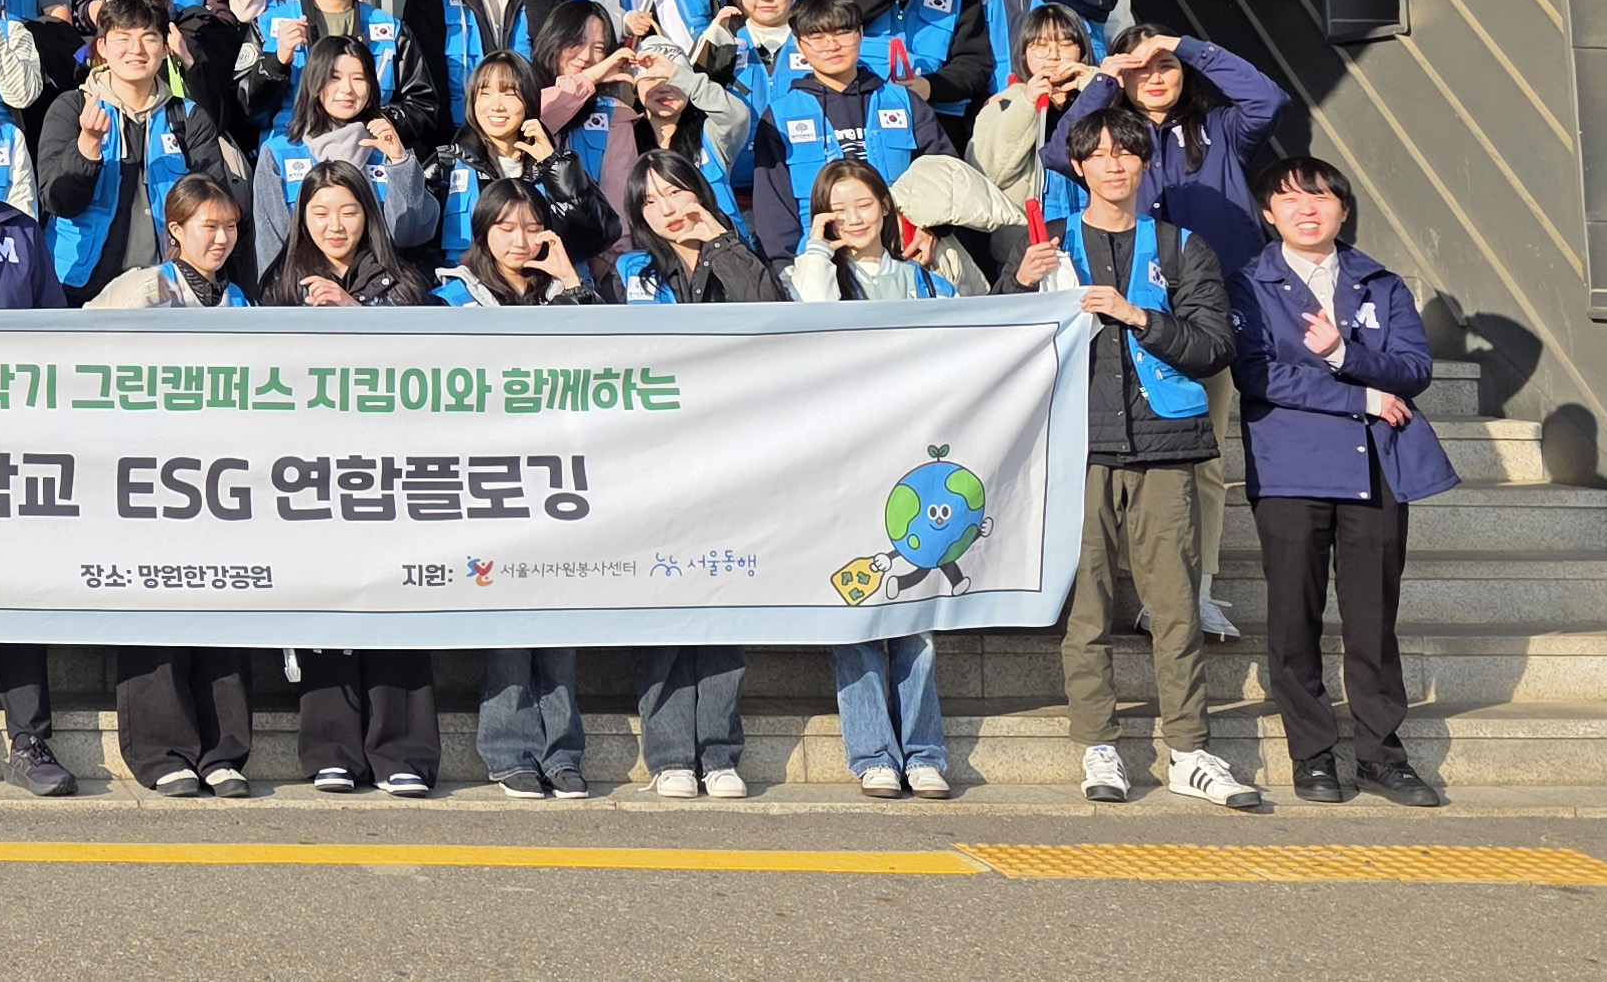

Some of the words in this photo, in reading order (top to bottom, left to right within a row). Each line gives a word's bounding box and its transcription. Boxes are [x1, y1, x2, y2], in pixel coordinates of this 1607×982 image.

[71, 364, 296, 411] 그린캠퍼스
[306, 367, 493, 413] 지킴이와
[501, 367, 682, 412] 함께하는
[116, 456, 253, 521] ESG
[270, 454, 590, 522] 연합플로깅
[80, 564, 133, 589] 장소:
[137, 564, 273, 590] 망원한강공원
[401, 564, 454, 587] 지원:
[500, 560, 637, 578] 서울시자원봉사센터
[687, 550, 757, 578] 서울동행
